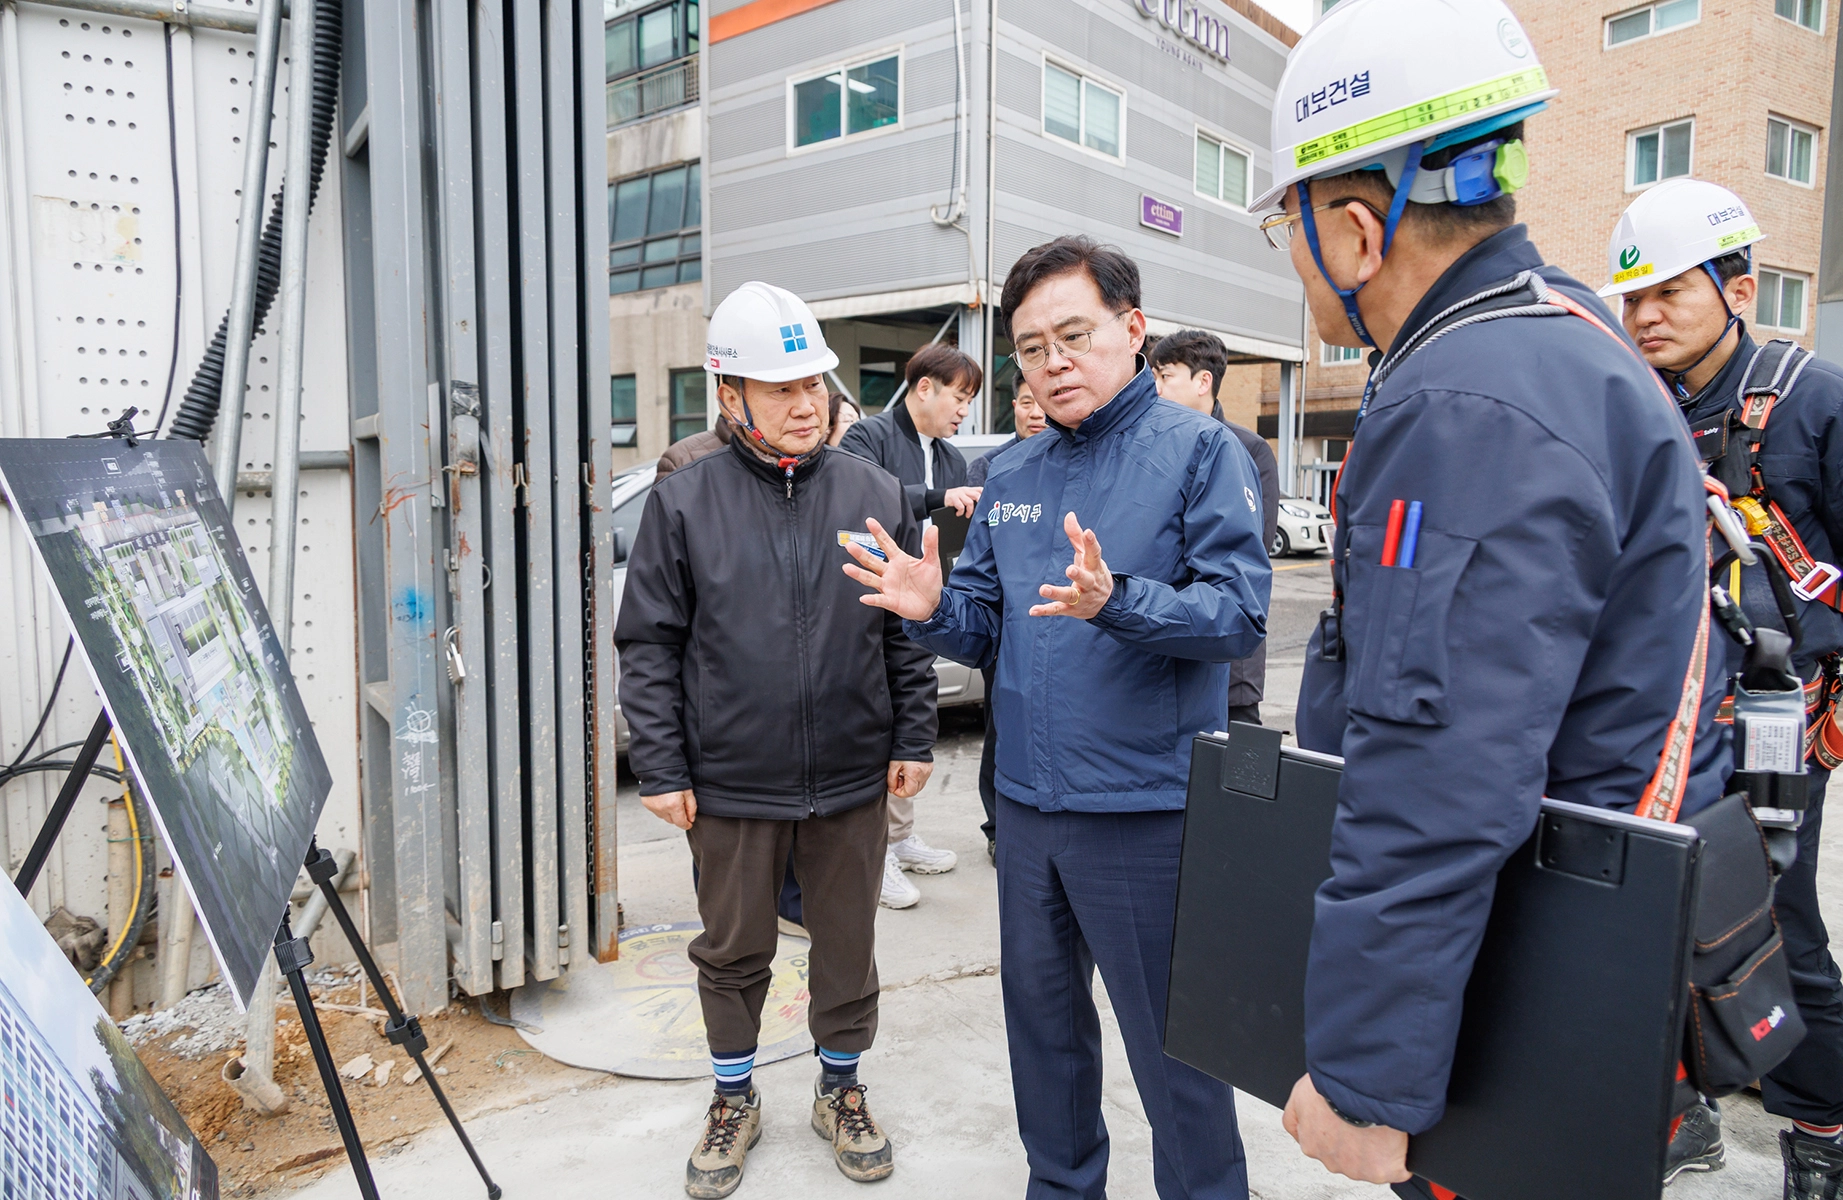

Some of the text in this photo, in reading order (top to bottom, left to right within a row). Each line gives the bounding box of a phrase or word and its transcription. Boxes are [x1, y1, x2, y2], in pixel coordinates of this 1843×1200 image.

[1296, 70, 1371, 122] 대보건설
[1151, 203, 1174, 222] ettim
[1707, 205, 1745, 226] 대보건설
[1002, 502, 1042, 523] 강서구
